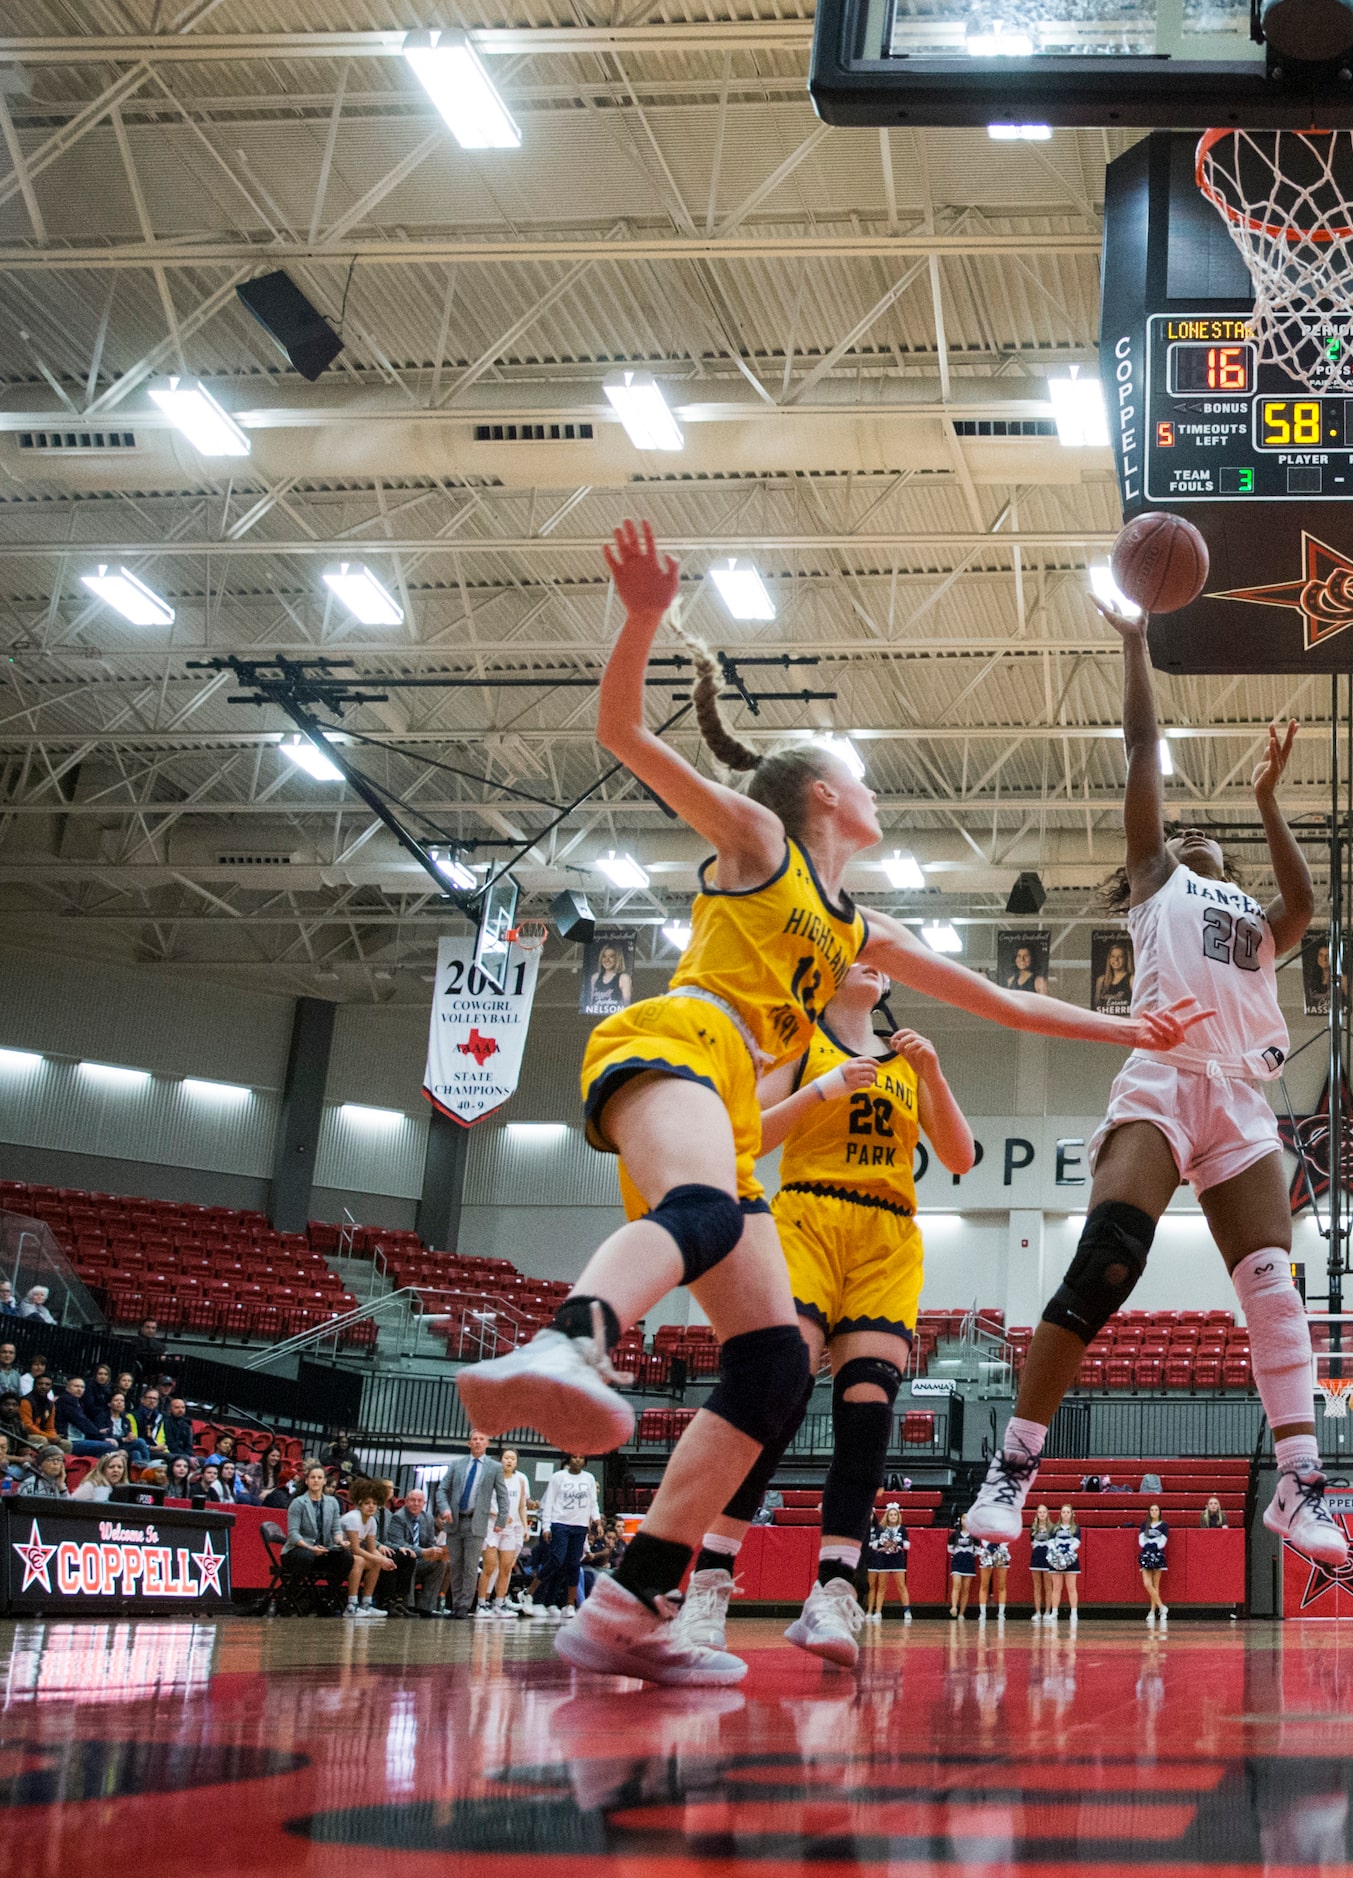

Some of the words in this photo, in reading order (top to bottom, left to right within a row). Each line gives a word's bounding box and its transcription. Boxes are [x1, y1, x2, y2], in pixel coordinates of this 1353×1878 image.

[1326, 338, 1341, 360] 2
[1207, 348, 1245, 388] 16
[1203, 403, 1249, 414] BONUS
[1115, 336, 1140, 500] COPPELL
[1158, 423, 1173, 445] 5
[1178, 423, 1247, 435] TIMEOUTS
[1195, 435, 1229, 447] LEFT
[1278, 454, 1329, 465] PLAYER
[1174, 469, 1210, 481] TEAM
[1238, 468, 1252, 491] 3
[1169, 480, 1214, 492] FOULS
[1202, 906, 1263, 972] 20
[452, 1000, 513, 1011] COWGIRL
[585, 1005, 625, 1014] NELSON
[441, 1013, 522, 1024] VOLLEYBALL
[453, 1072, 494, 1082] STATE
[434, 1084, 511, 1096] CHAMPIONS
[846, 1142, 897, 1168] PARK
[99, 1521, 145, 1543] Welcome
[57, 1541, 199, 1598] COPPELL
